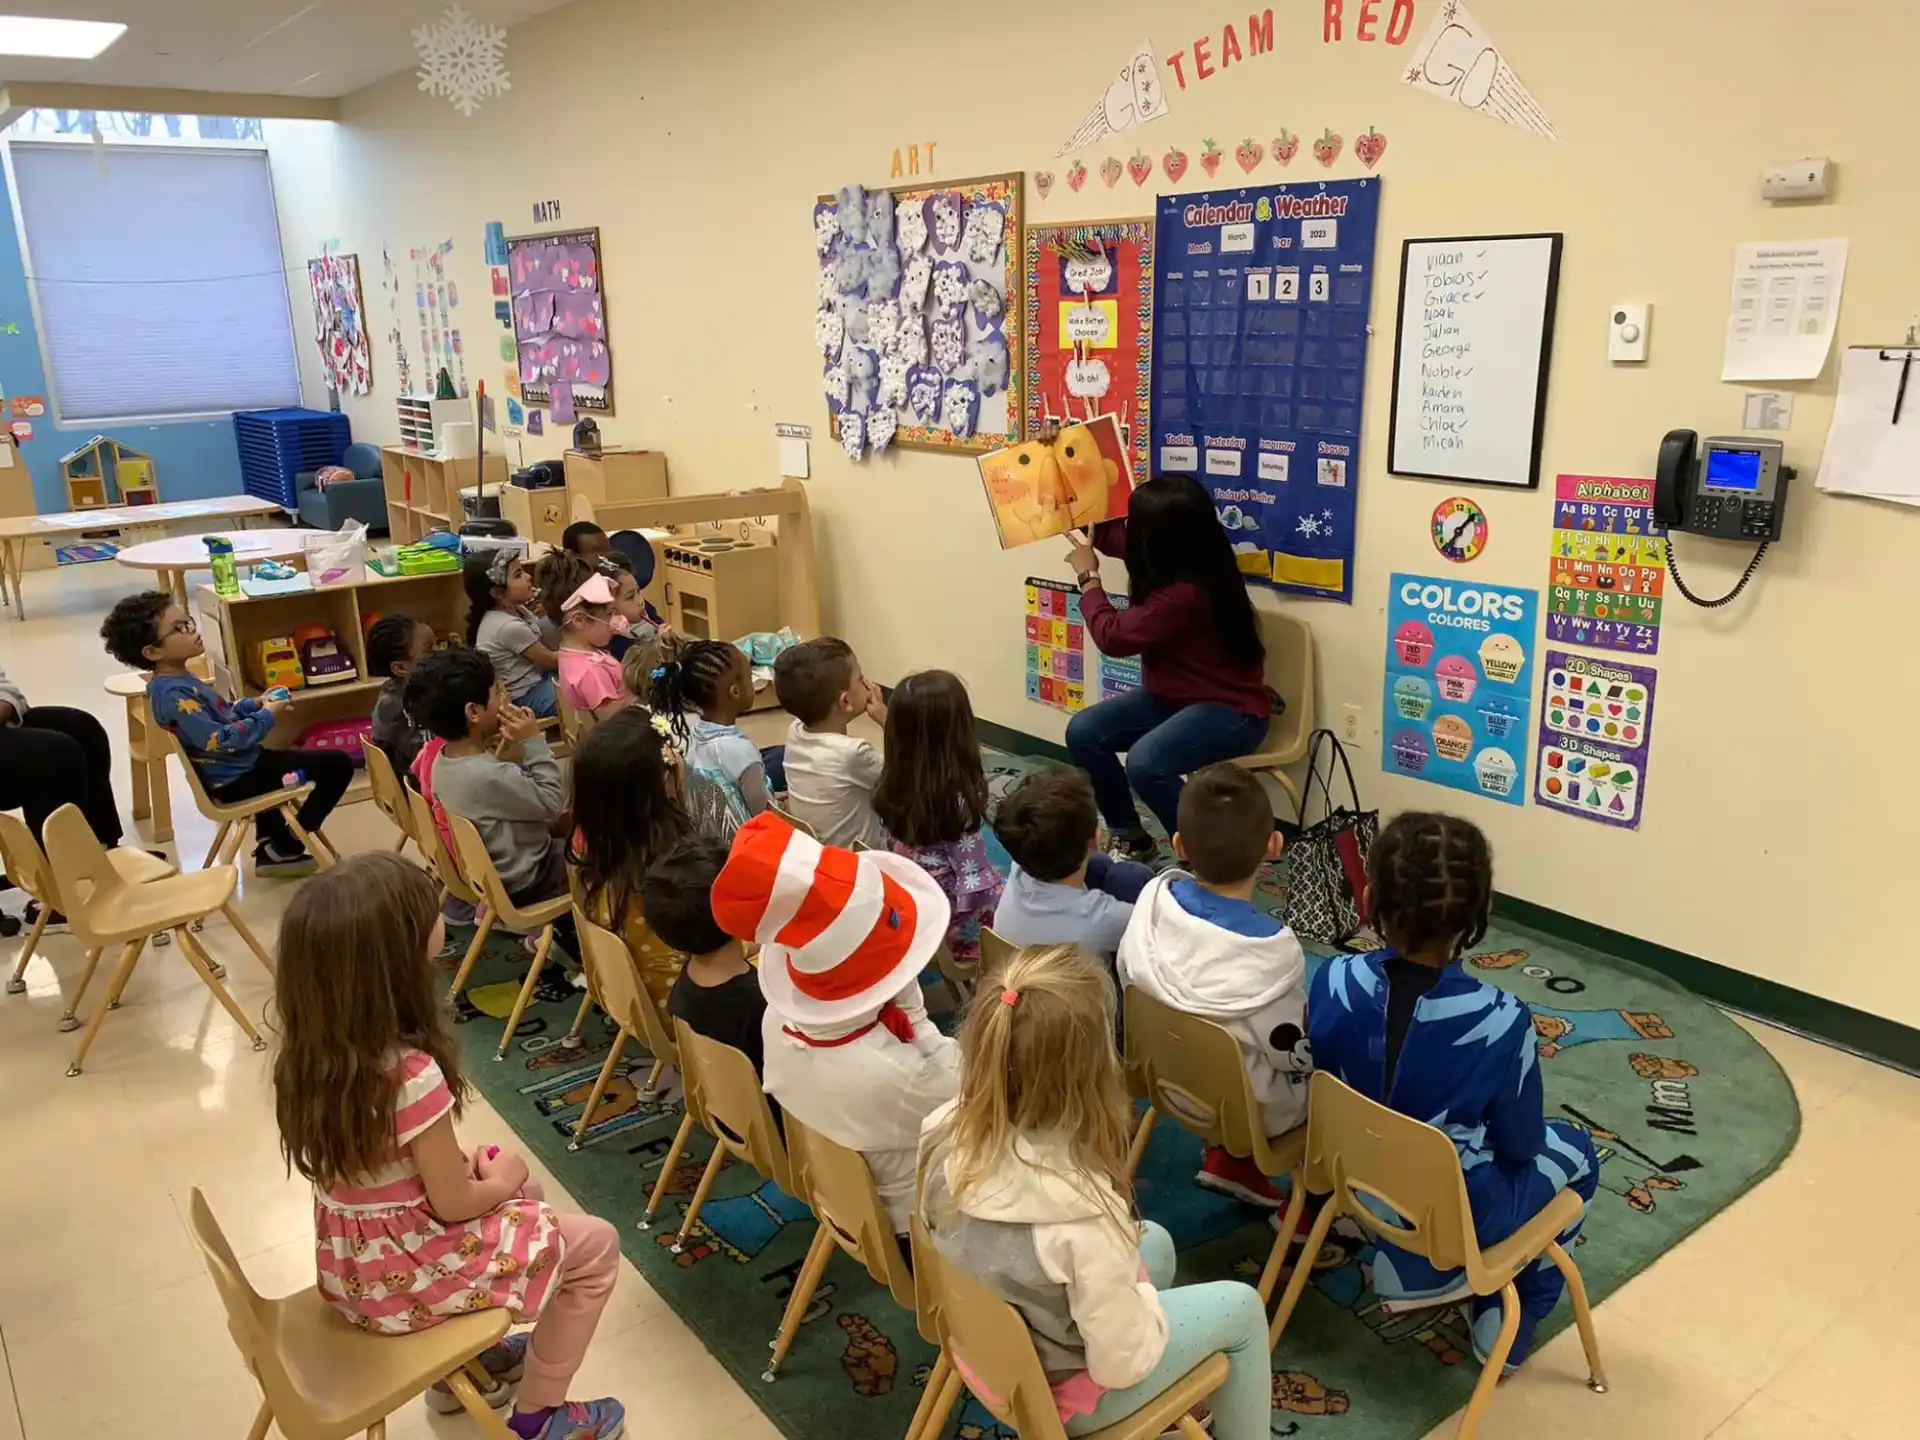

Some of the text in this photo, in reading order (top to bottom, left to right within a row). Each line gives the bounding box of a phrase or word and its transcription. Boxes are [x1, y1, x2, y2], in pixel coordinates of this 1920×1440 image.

[1166, 0, 1414, 91] TEAM RED
[1424, 24, 1499, 109] GO
[1103, 53, 1162, 132] GO
[891, 142, 937, 178] ART
[533, 200, 561, 223] MATH
[1184, 193, 1347, 227] Calendar & Weather
[1227, 233, 1246, 241] March
[1310, 230, 1326, 238] 2023
[1090, 267, 1107, 278] Job!
[1424, 272, 1475, 288] Tobias
[1255, 280, 1262, 294] 1
[1282, 279, 1291, 294] 2
[1315, 280, 1322, 295] 3
[1424, 290, 1471, 307] Grace
[1424, 307, 1454, 320] Noah
[1423, 323, 1459, 341] Julian
[1422, 342, 1471, 359] George
[1076, 373, 1085, 382] Uh
[1422, 363, 1462, 380] Noble
[1422, 400, 1465, 414] Amara
[1420, 416, 1458, 433] Chloe
[1165, 433, 1194, 446] Today
[1204, 435, 1246, 450] Yesterday
[1423, 435, 1463, 449] Micah
[1318, 441, 1349, 456] Season
[1170, 455, 1188, 464] Friday
[1210, 457, 1236, 468] Thursday
[1576, 480, 1650, 501] Alphabet
[1561, 502, 1576, 513] Aa
[1582, 504, 1597, 515] Bb
[1602, 506, 1618, 517] Cc
[1624, 507, 1640, 518] Dd
[1560, 531, 1571, 541] Ff
[1576, 532, 1590, 545] Gg
[1596, 535, 1610, 545] Hh
[1629, 537, 1639, 550] Jj
[1646, 539, 1660, 550] Kk
[1574, 560, 1592, 572] Mm
[1598, 564, 1612, 574] Nn
[1619, 566, 1635, 577] Oo
[1642, 568, 1656, 581] Pp
[1401, 582, 1524, 621] COLORS
[1555, 586, 1655, 608] Qq Rr Ss Tt Uu
[1428, 613, 1491, 632] COLORES
[1553, 614, 1652, 638] Vv Ww Xx Yy Zz
[1406, 645, 1420, 654] RED
[1485, 659, 1516, 670] YELLOW
[1567, 658, 1632, 682] 2D Shapes
[1487, 671, 1514, 680] AMARILLO
[1447, 680, 1464, 689] PINK
[1401, 698, 1424, 709] GREEN
[1488, 716, 1507, 727] BLUE
[1436, 737, 1468, 750] ORANGE
[1559, 737, 1621, 762] 3D Shapes
[1483, 771, 1507, 783] WHITE
[1482, 782, 1507, 793] BLANCO
